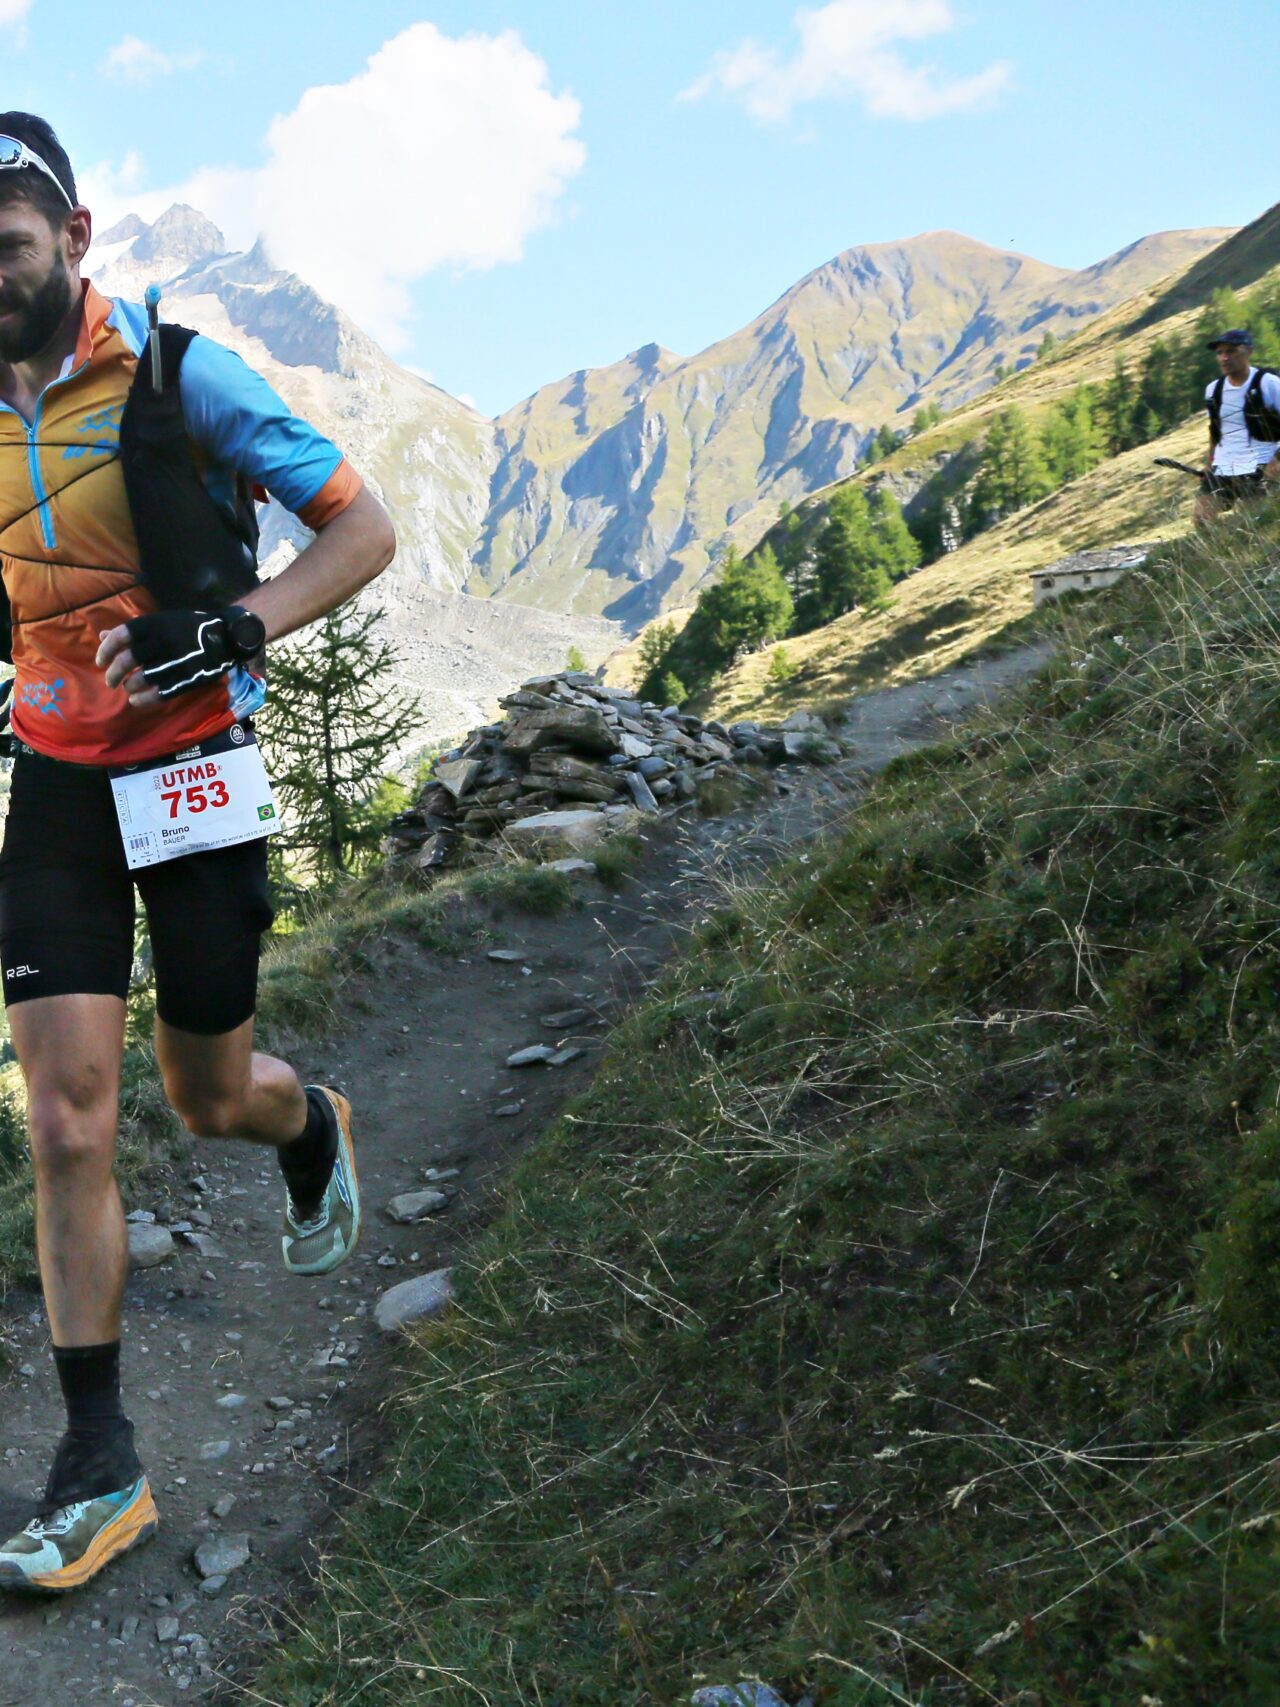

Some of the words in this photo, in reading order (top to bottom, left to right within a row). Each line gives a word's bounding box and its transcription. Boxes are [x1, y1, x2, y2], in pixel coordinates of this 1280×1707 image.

[161, 762, 217, 788] UTMB
[160, 780, 230, 819] 753
[161, 825, 190, 838] Bruno
